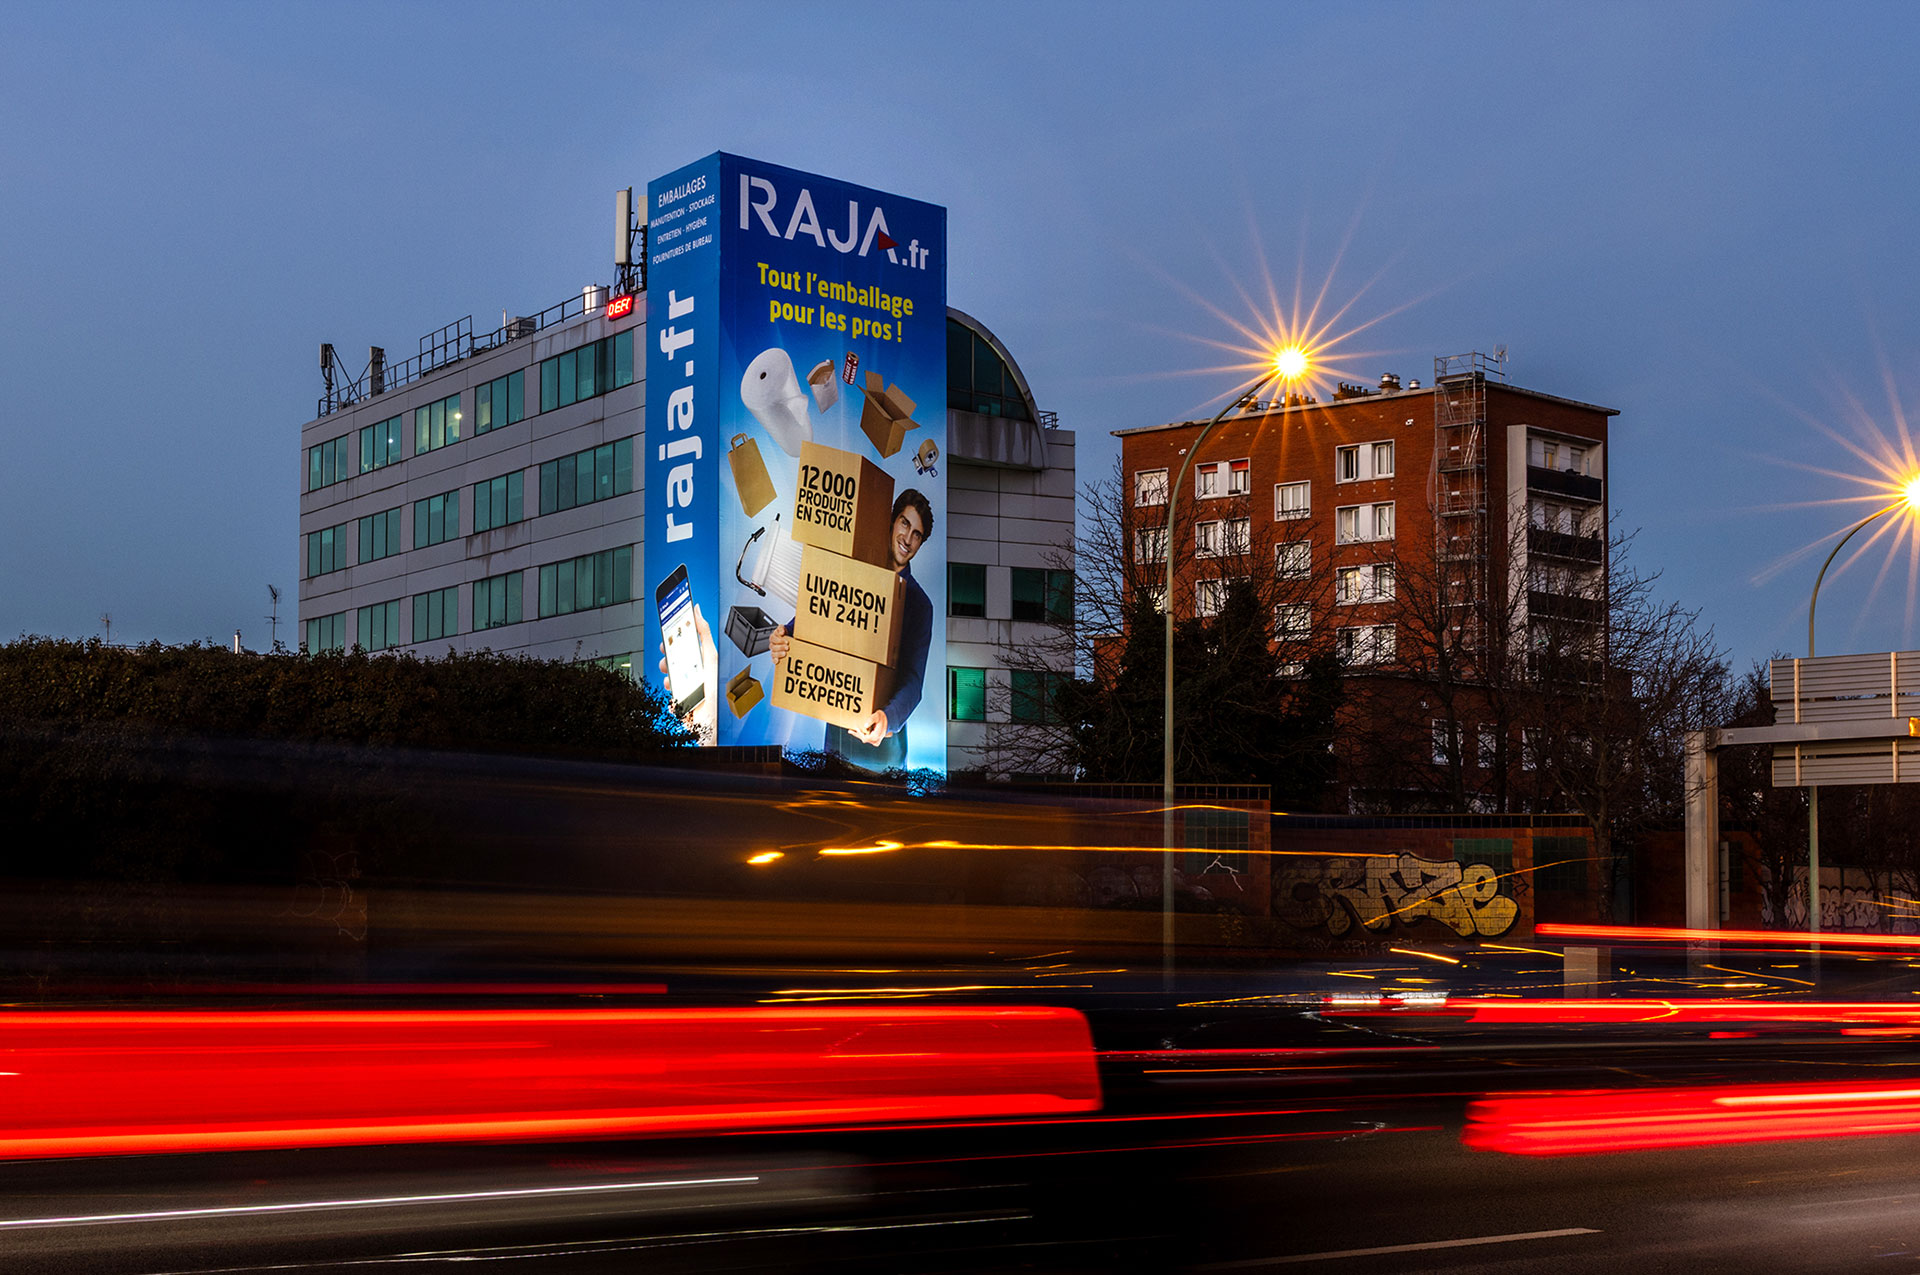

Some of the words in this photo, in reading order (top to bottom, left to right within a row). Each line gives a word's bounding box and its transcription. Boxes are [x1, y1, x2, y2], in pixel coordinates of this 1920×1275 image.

[658, 175, 707, 208] EMBALLAGES
[650, 208, 685, 229] MANUTENTION
[688, 194, 715, 213] STOCKAGE
[739, 173, 929, 270] RAJA.fr
[657, 227, 682, 245] ENTRETIEN
[685, 216, 707, 233] HYGIÈNE
[652, 246, 684, 265] FOURNITURES
[685, 242, 692, 252] DE
[692, 234, 712, 249] BUREAU
[757, 262, 801, 292] Tout
[806, 272, 914, 319] l'emballage
[770, 299, 815, 325] pour
[820, 308, 847, 332] les
[852, 317, 892, 343] pros
[658, 289, 703, 543] raja.fr
[796, 504, 813, 522] EN
[814, 509, 853, 533] STOCK
[798, 488, 854, 516] PRODUITS
[805, 573, 887, 615] LIVRAISON
[809, 596, 831, 619] EN
[835, 605, 868, 630] 24H
[787, 656, 803, 677] LE
[806, 663, 864, 695] CONSEIL
[784, 676, 862, 713] D'EXPERTS
